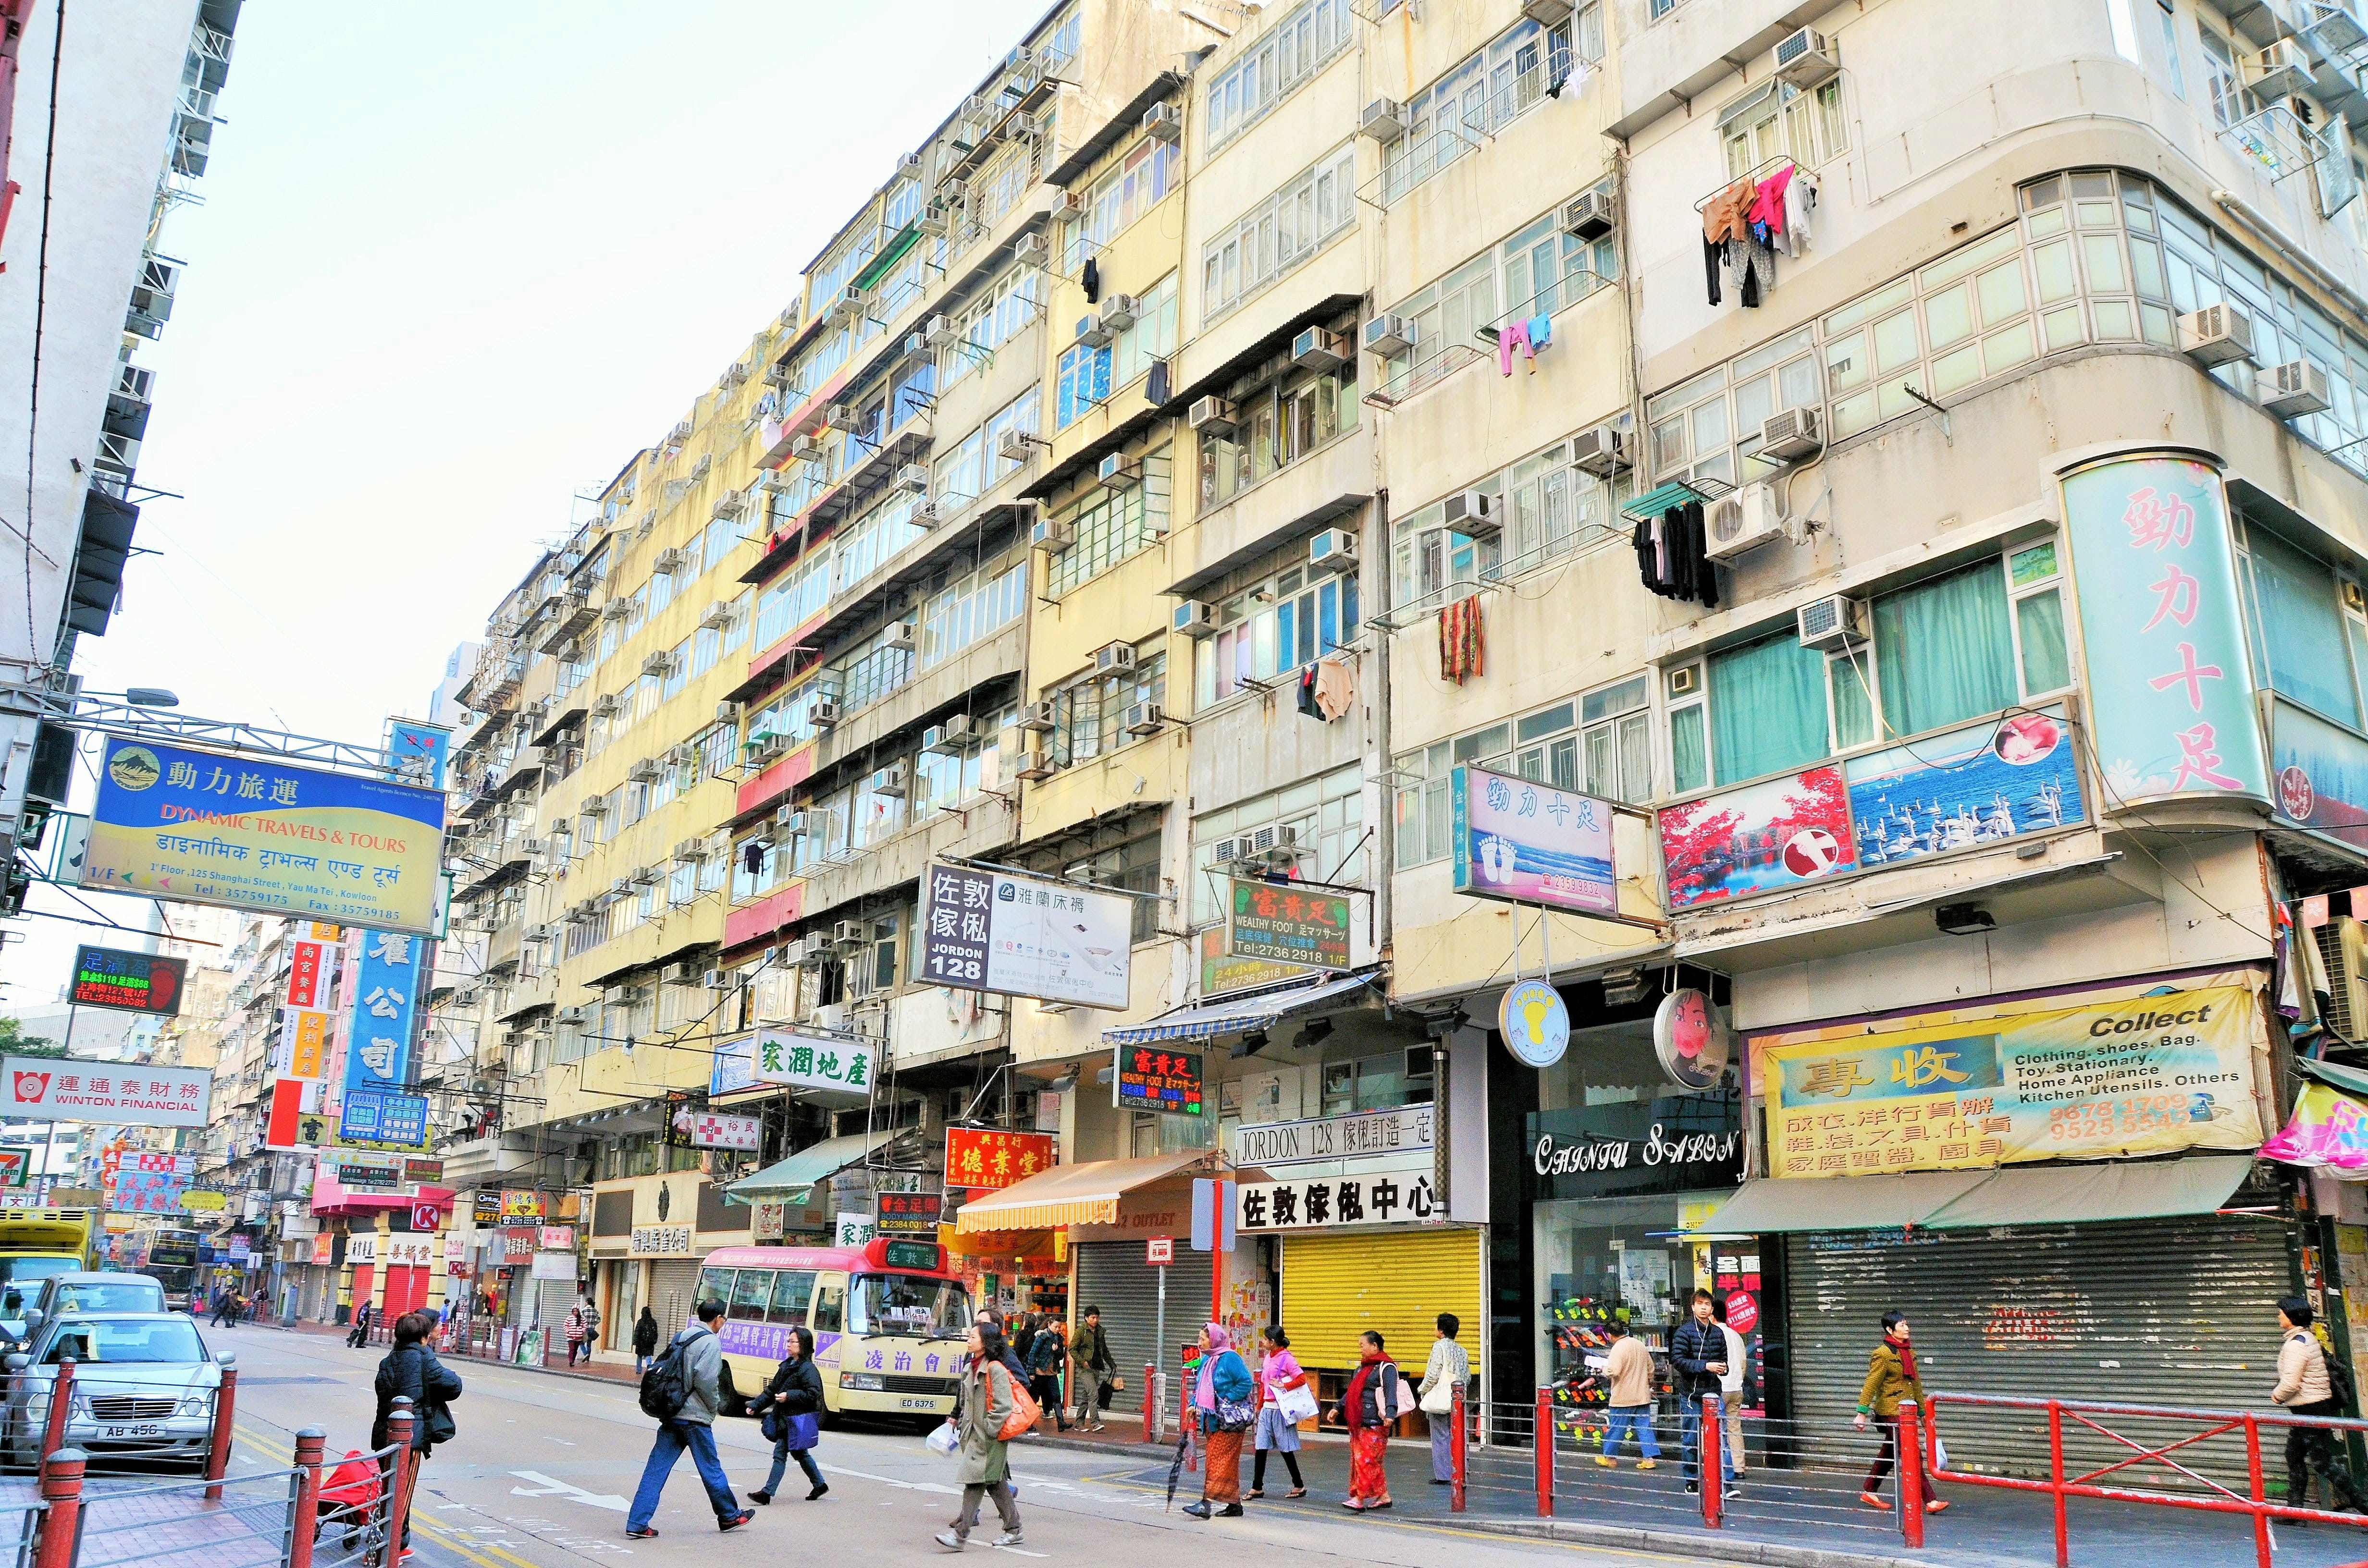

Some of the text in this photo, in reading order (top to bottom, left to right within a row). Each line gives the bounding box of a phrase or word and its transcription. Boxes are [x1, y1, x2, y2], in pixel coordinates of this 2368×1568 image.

[2122, 487, 2245, 794] 勁力十足
[167, 761, 299, 806] 動力旅運
[1487, 777, 1600, 832] 勁力十足
[160, 804, 406, 853] DYNAMIC TRAVELS & TOURS
[90, 867, 115, 880] 1/F
[161, 865, 185, 876] Floor
[210, 871, 251, 885] Shanghai
[288, 883, 303, 892] Yau
[306, 885, 318, 894] Ma
[341, 890, 377, 902] Kowloon
[1555, 876, 1576, 891] 2359
[225, 888, 287, 905] 35759175
[933, 873, 990, 910] 佐敦
[1018, 887, 1085, 913] 雅蘭床褥
[341, 904, 400, 919] 35759185
[1253, 888, 1336, 925] 富貴足
[931, 906, 987, 943] 傢俬
[1235, 916, 1293, 933] WEALTHY FOOT
[932, 943, 982, 959] JORDON
[1235, 941, 1346, 965] Tel:2736 2918 1/F
[295, 946, 314, 1004] 尚宮餐廳
[931, 956, 981, 980] 128
[1258, 968, 1281, 981] 2918
[2089, 1004, 2211, 1037] Collect
[299, 1016, 320, 1075] 便利廚房
[761, 1040, 868, 1086] 家潤地產
[1134, 1049, 1193, 1078] 富貴足
[1800, 1046, 1970, 1097] 專收
[57, 1076, 200, 1099] 運通泰財務
[2019, 1065, 2159, 1090] Home Appliance
[2020, 1088, 2085, 1104] Kitchen
[2174, 1071, 2240, 1086] Others
[56, 1095, 198, 1112] WINTON FINANCIAL
[2049, 1092, 2189, 1123] 9678 1709
[728, 1120, 754, 1133] 裕民
[2051, 1110, 2192, 1141] 9525 5542
[723, 1136, 757, 1147] 大藥房
[979, 1134, 1022, 1148] 興昌行
[1243, 1127, 1300, 1161] JORDON
[1311, 1124, 1332, 1155] 128
[960, 1146, 1038, 1176] 德業堂
[1243, 1175, 1434, 1228] 佐敦傢俬中心
[888, 1249, 936, 1267] 佐敦道
[1716, 1255, 1761, 1273] 全面
[1716, 1274, 1762, 1292] 半價
[915, 1400, 934, 1408] 6375
[106, 1423, 158, 1437] AB 456
